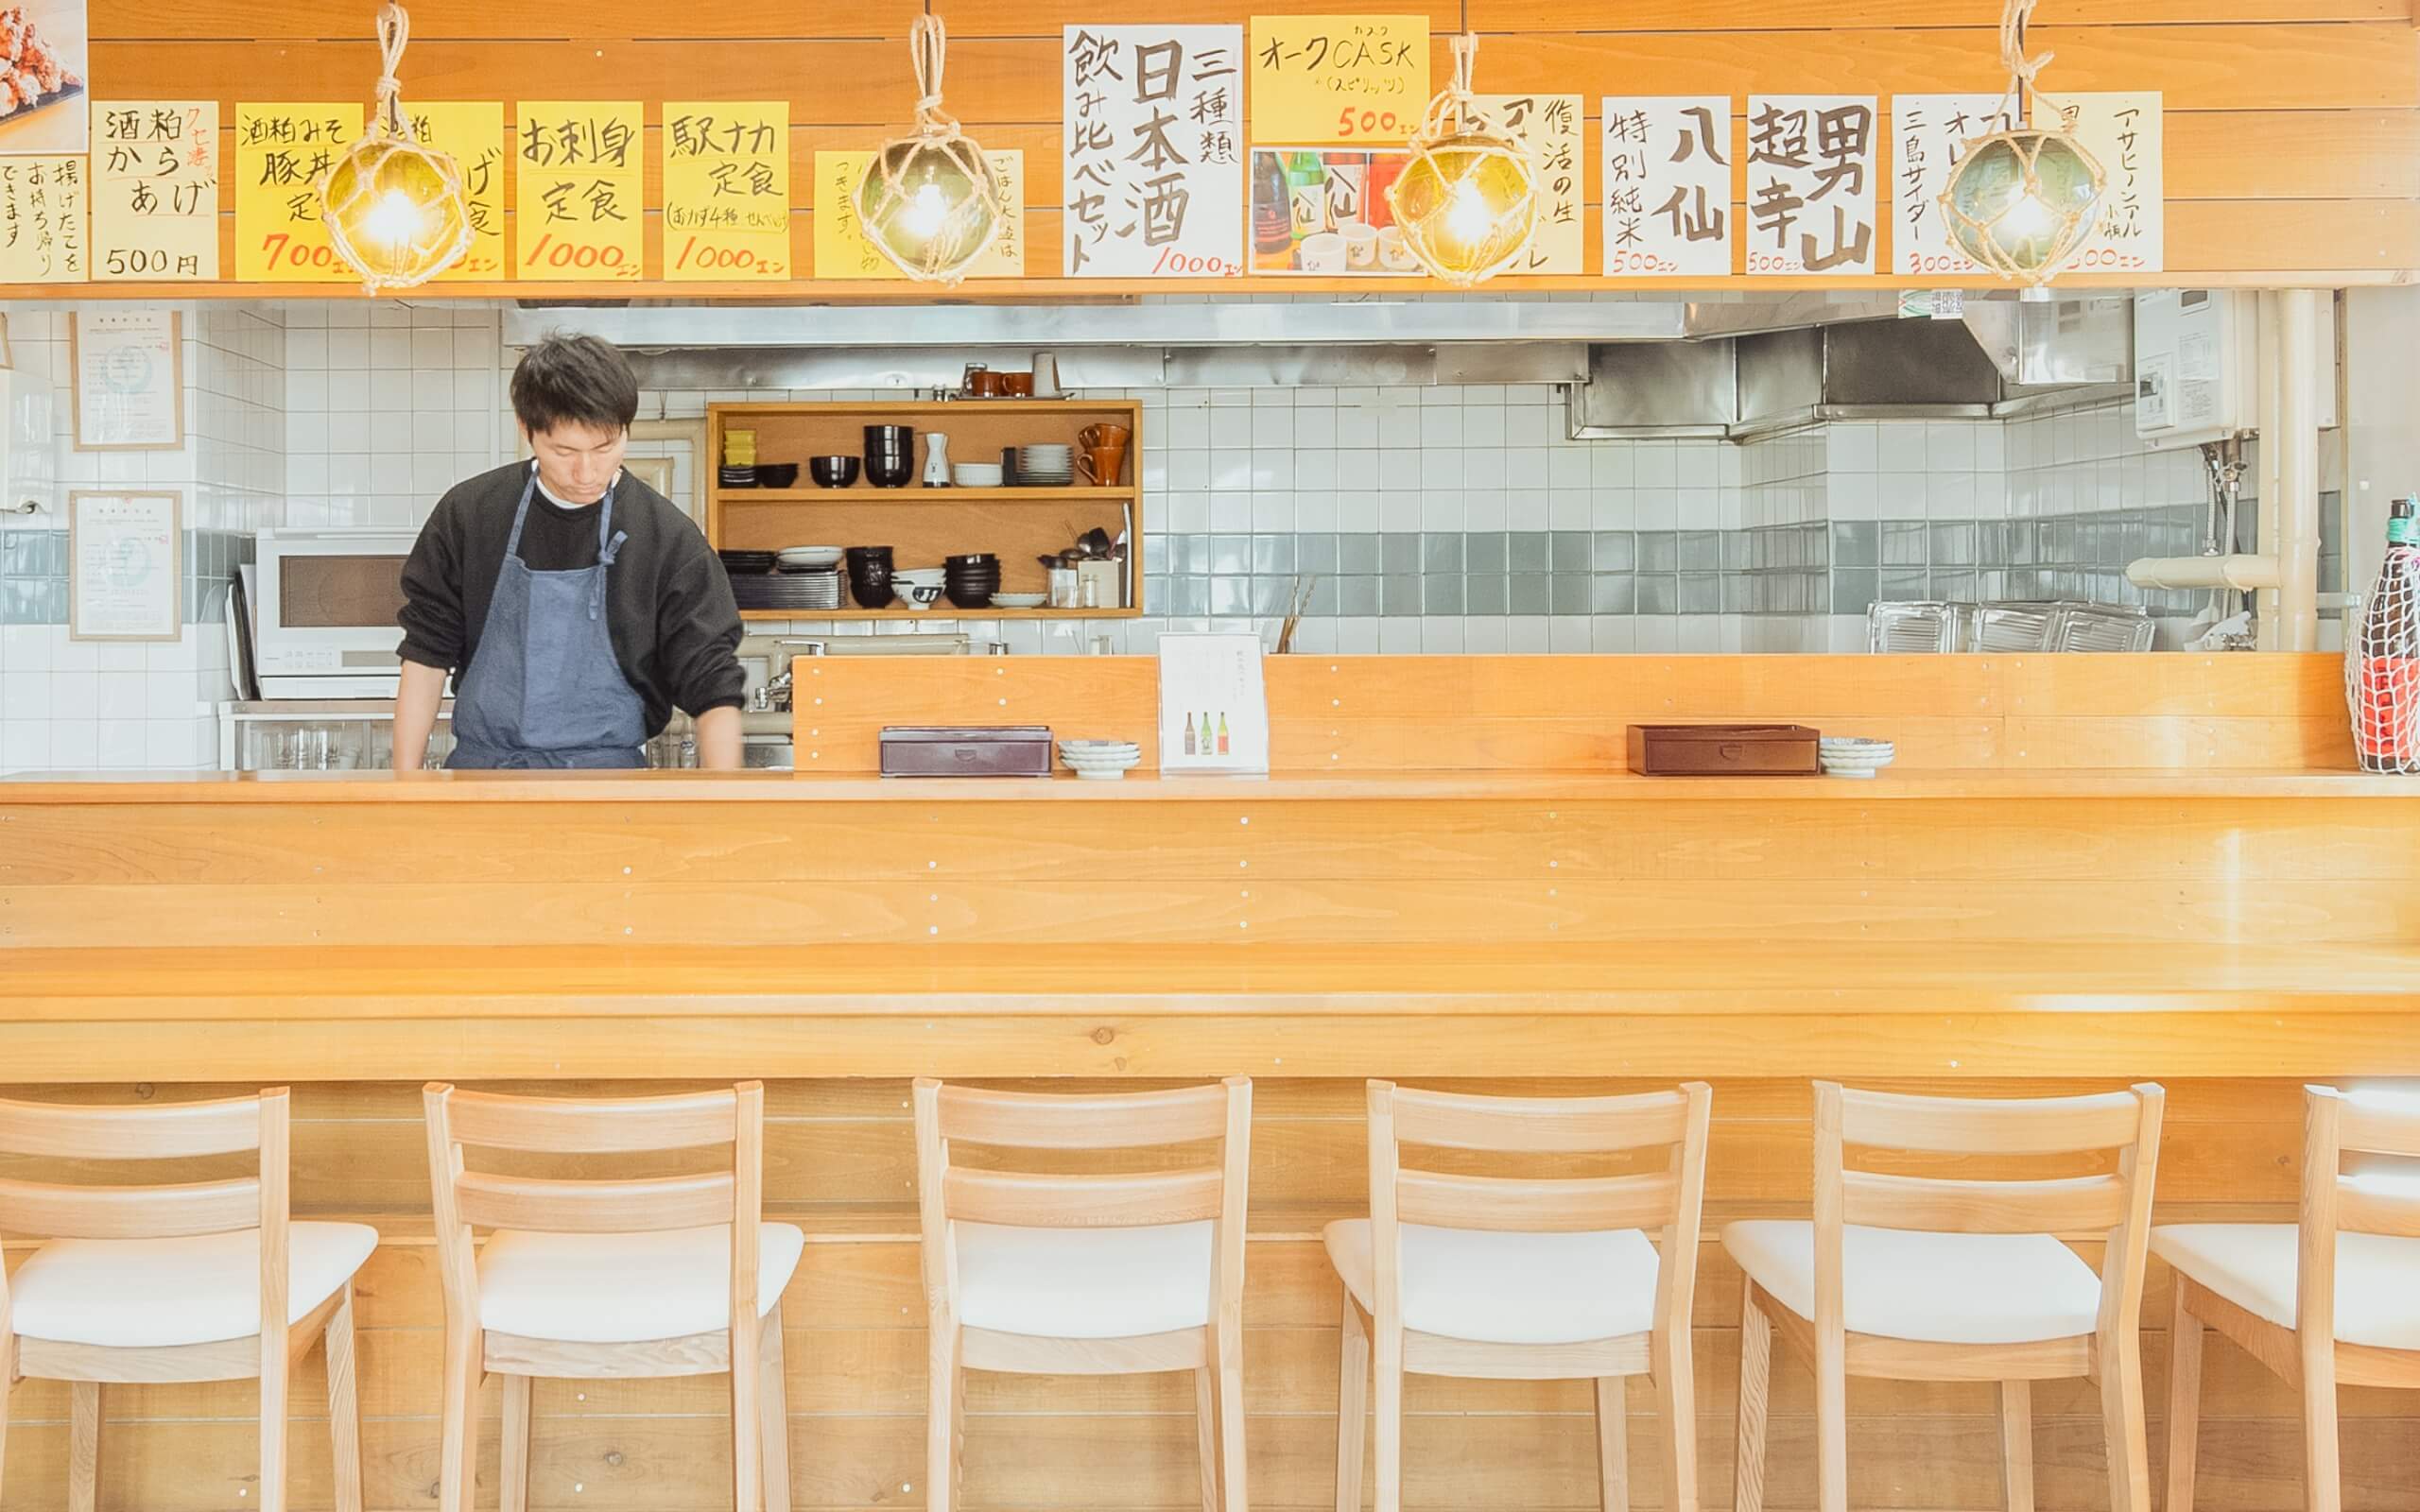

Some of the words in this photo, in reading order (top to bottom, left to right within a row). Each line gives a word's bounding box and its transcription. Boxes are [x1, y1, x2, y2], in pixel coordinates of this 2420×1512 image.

[106, 110, 182, 141] 酒粕
[241, 114, 347, 146] 酒粕みそ
[1189, 49, 1240, 165] 三種類
[107, 146, 180, 177] から
[521, 116, 635, 167] お刺身
[669, 115, 775, 159] 駅ナカ
[1068, 29, 1124, 275] 飲み比べセット
[1115, 39, 1190, 248] 日本酒
[1543, 99, 1579, 224] 復活の生
[131, 180, 217, 215] あげ
[708, 161, 784, 198] 定食
[1609, 110, 1652, 248] 特別純米
[1650, 106, 1731, 242] 八仙
[1802, 105, 1873, 272] 男山
[1902, 111, 1928, 240] 三島サイダー
[541, 180, 628, 225] 定食
[107, 249, 198, 276] 500円
